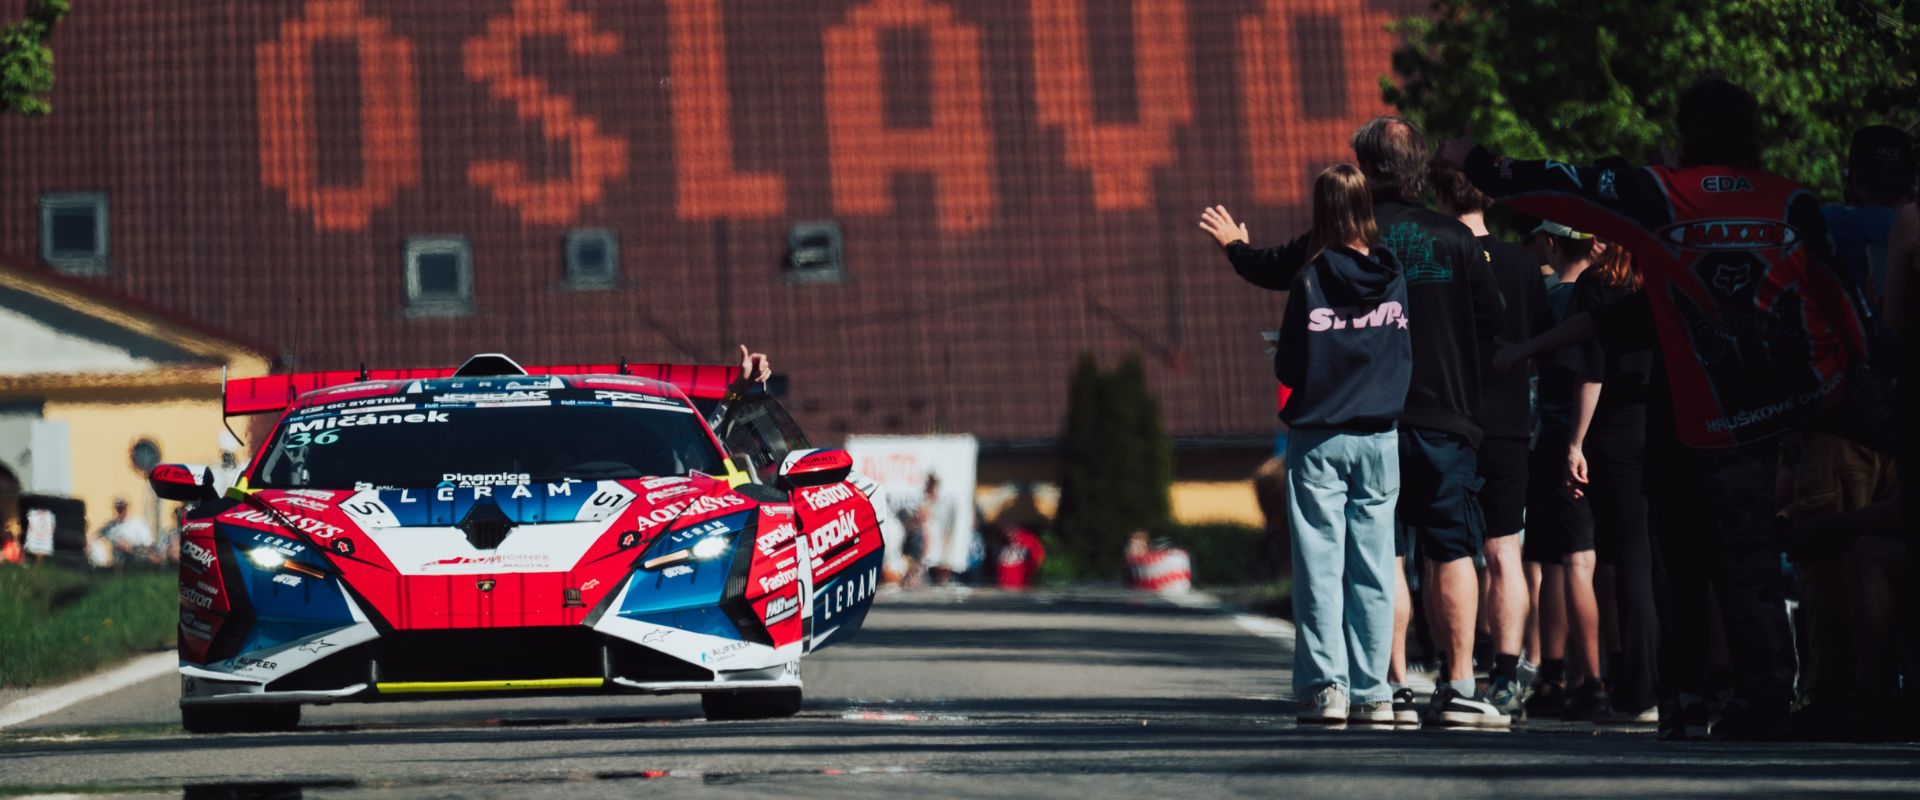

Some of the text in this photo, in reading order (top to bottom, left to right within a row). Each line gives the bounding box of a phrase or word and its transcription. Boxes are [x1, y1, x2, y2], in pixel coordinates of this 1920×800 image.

[1701, 175, 1755, 193] EDA
[1683, 222, 1788, 247] MAXXIS
[288, 410, 449, 435] Mičánek
[286, 428, 342, 449] 36
[442, 472, 531, 482] Dinamica
[400, 483, 572, 503] LERAM
[801, 482, 854, 511] Fastron
[253, 533, 306, 553] LERAM
[671, 520, 725, 543] LERAM
[808, 509, 860, 558] JORDÁK
[182, 540, 217, 568] ORDÁK
[824, 566, 877, 620] LERAM
